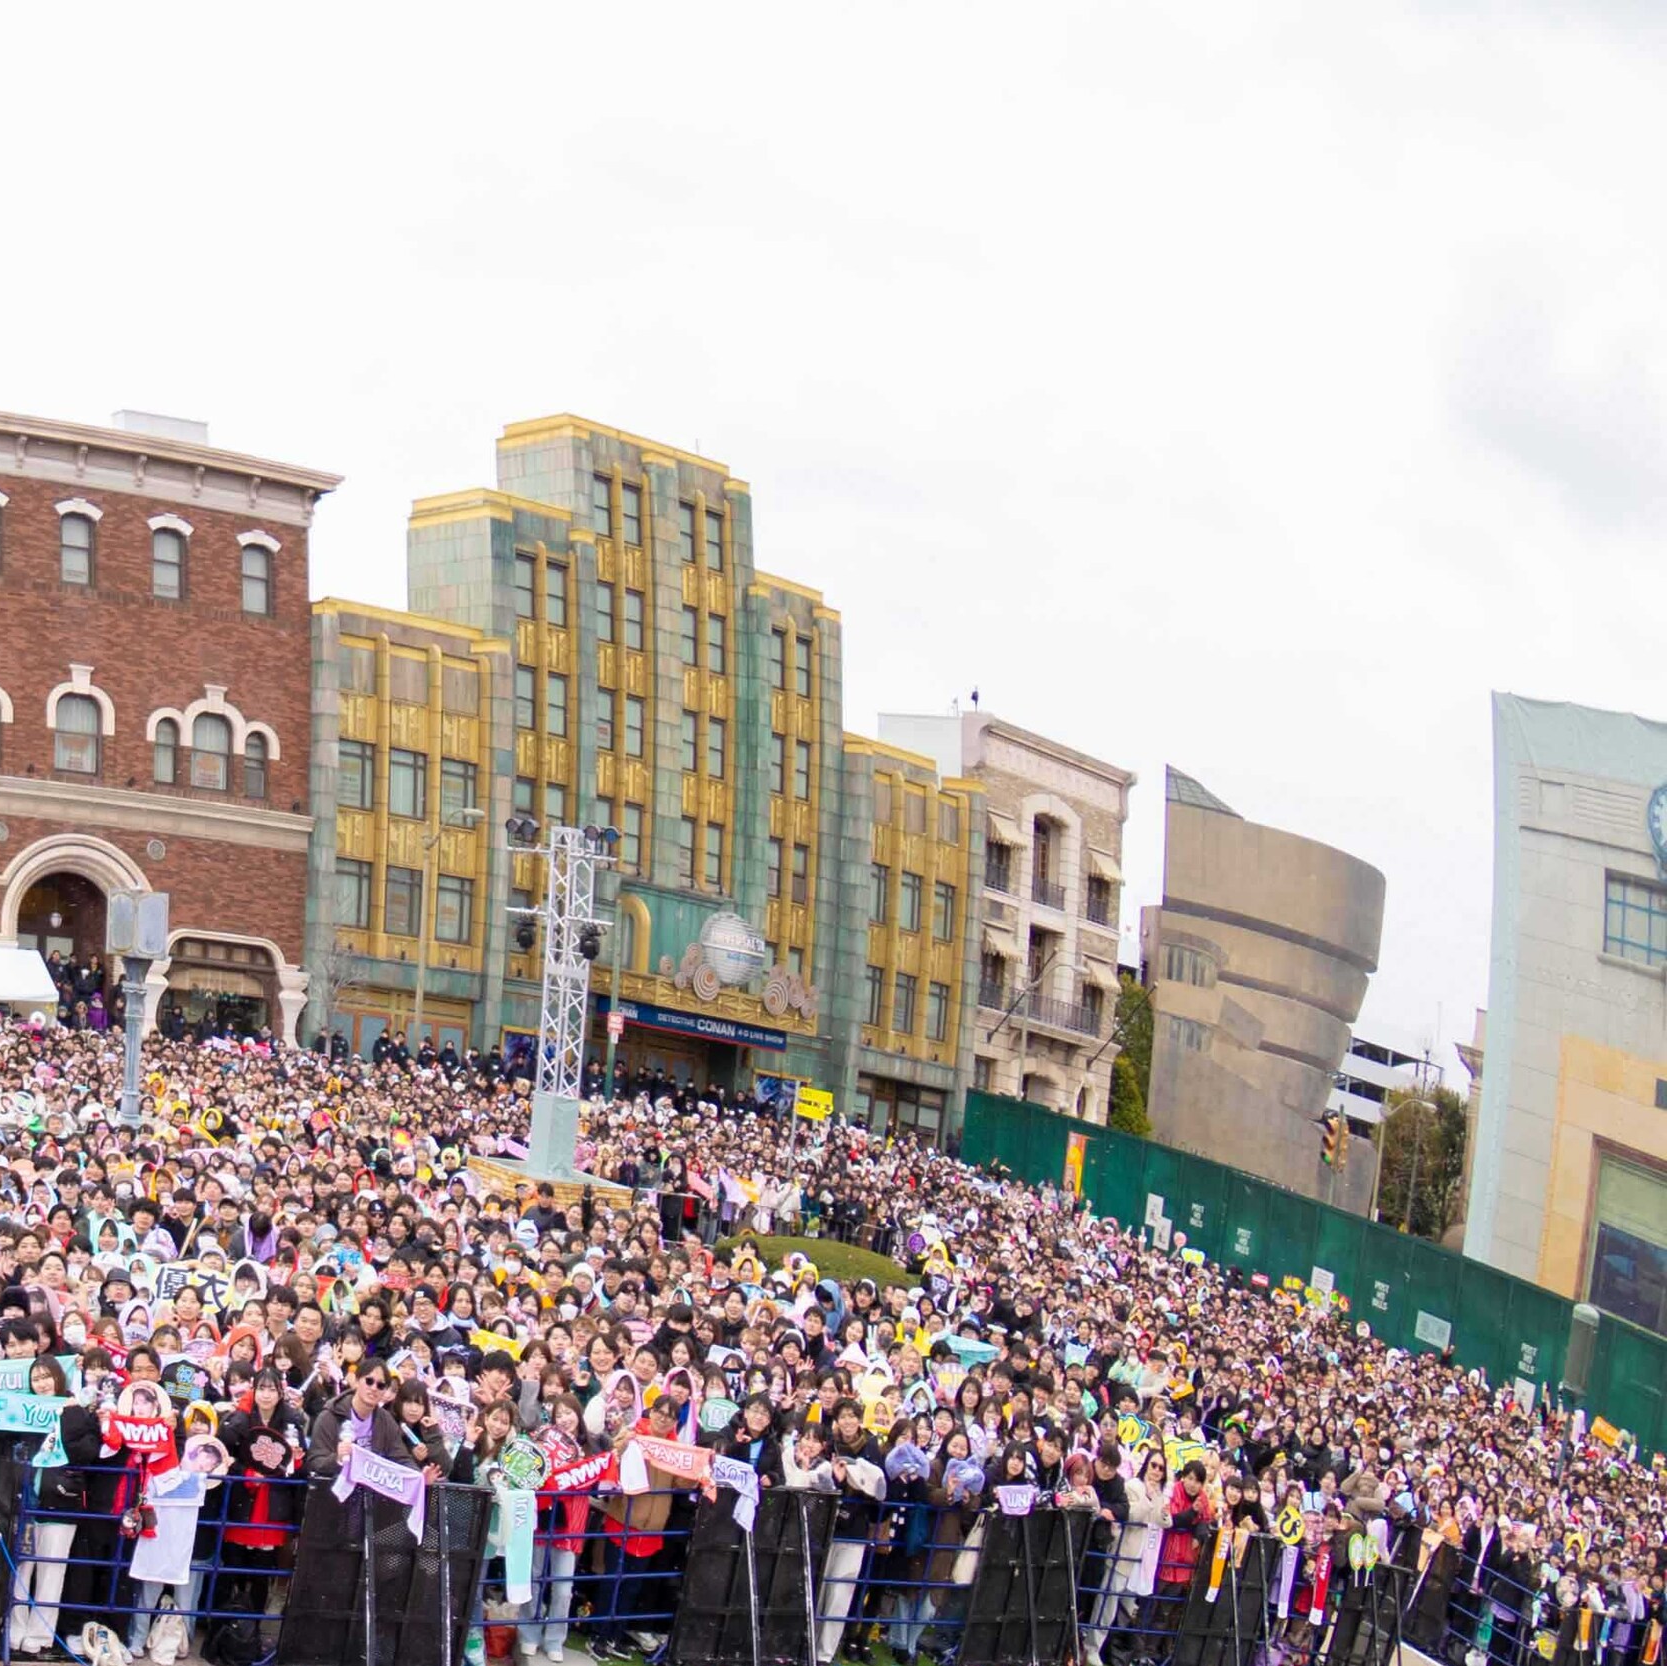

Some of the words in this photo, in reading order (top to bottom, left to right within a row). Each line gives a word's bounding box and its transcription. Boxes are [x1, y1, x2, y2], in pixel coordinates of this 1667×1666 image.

[657, 1013, 696, 1027] DETECTIVE
[696, 1018, 736, 1037] CONAN
[154, 1266, 229, 1313] 優衣
[363, 1459, 404, 1492] LUNA
[554, 1451, 611, 1491] AMANE
